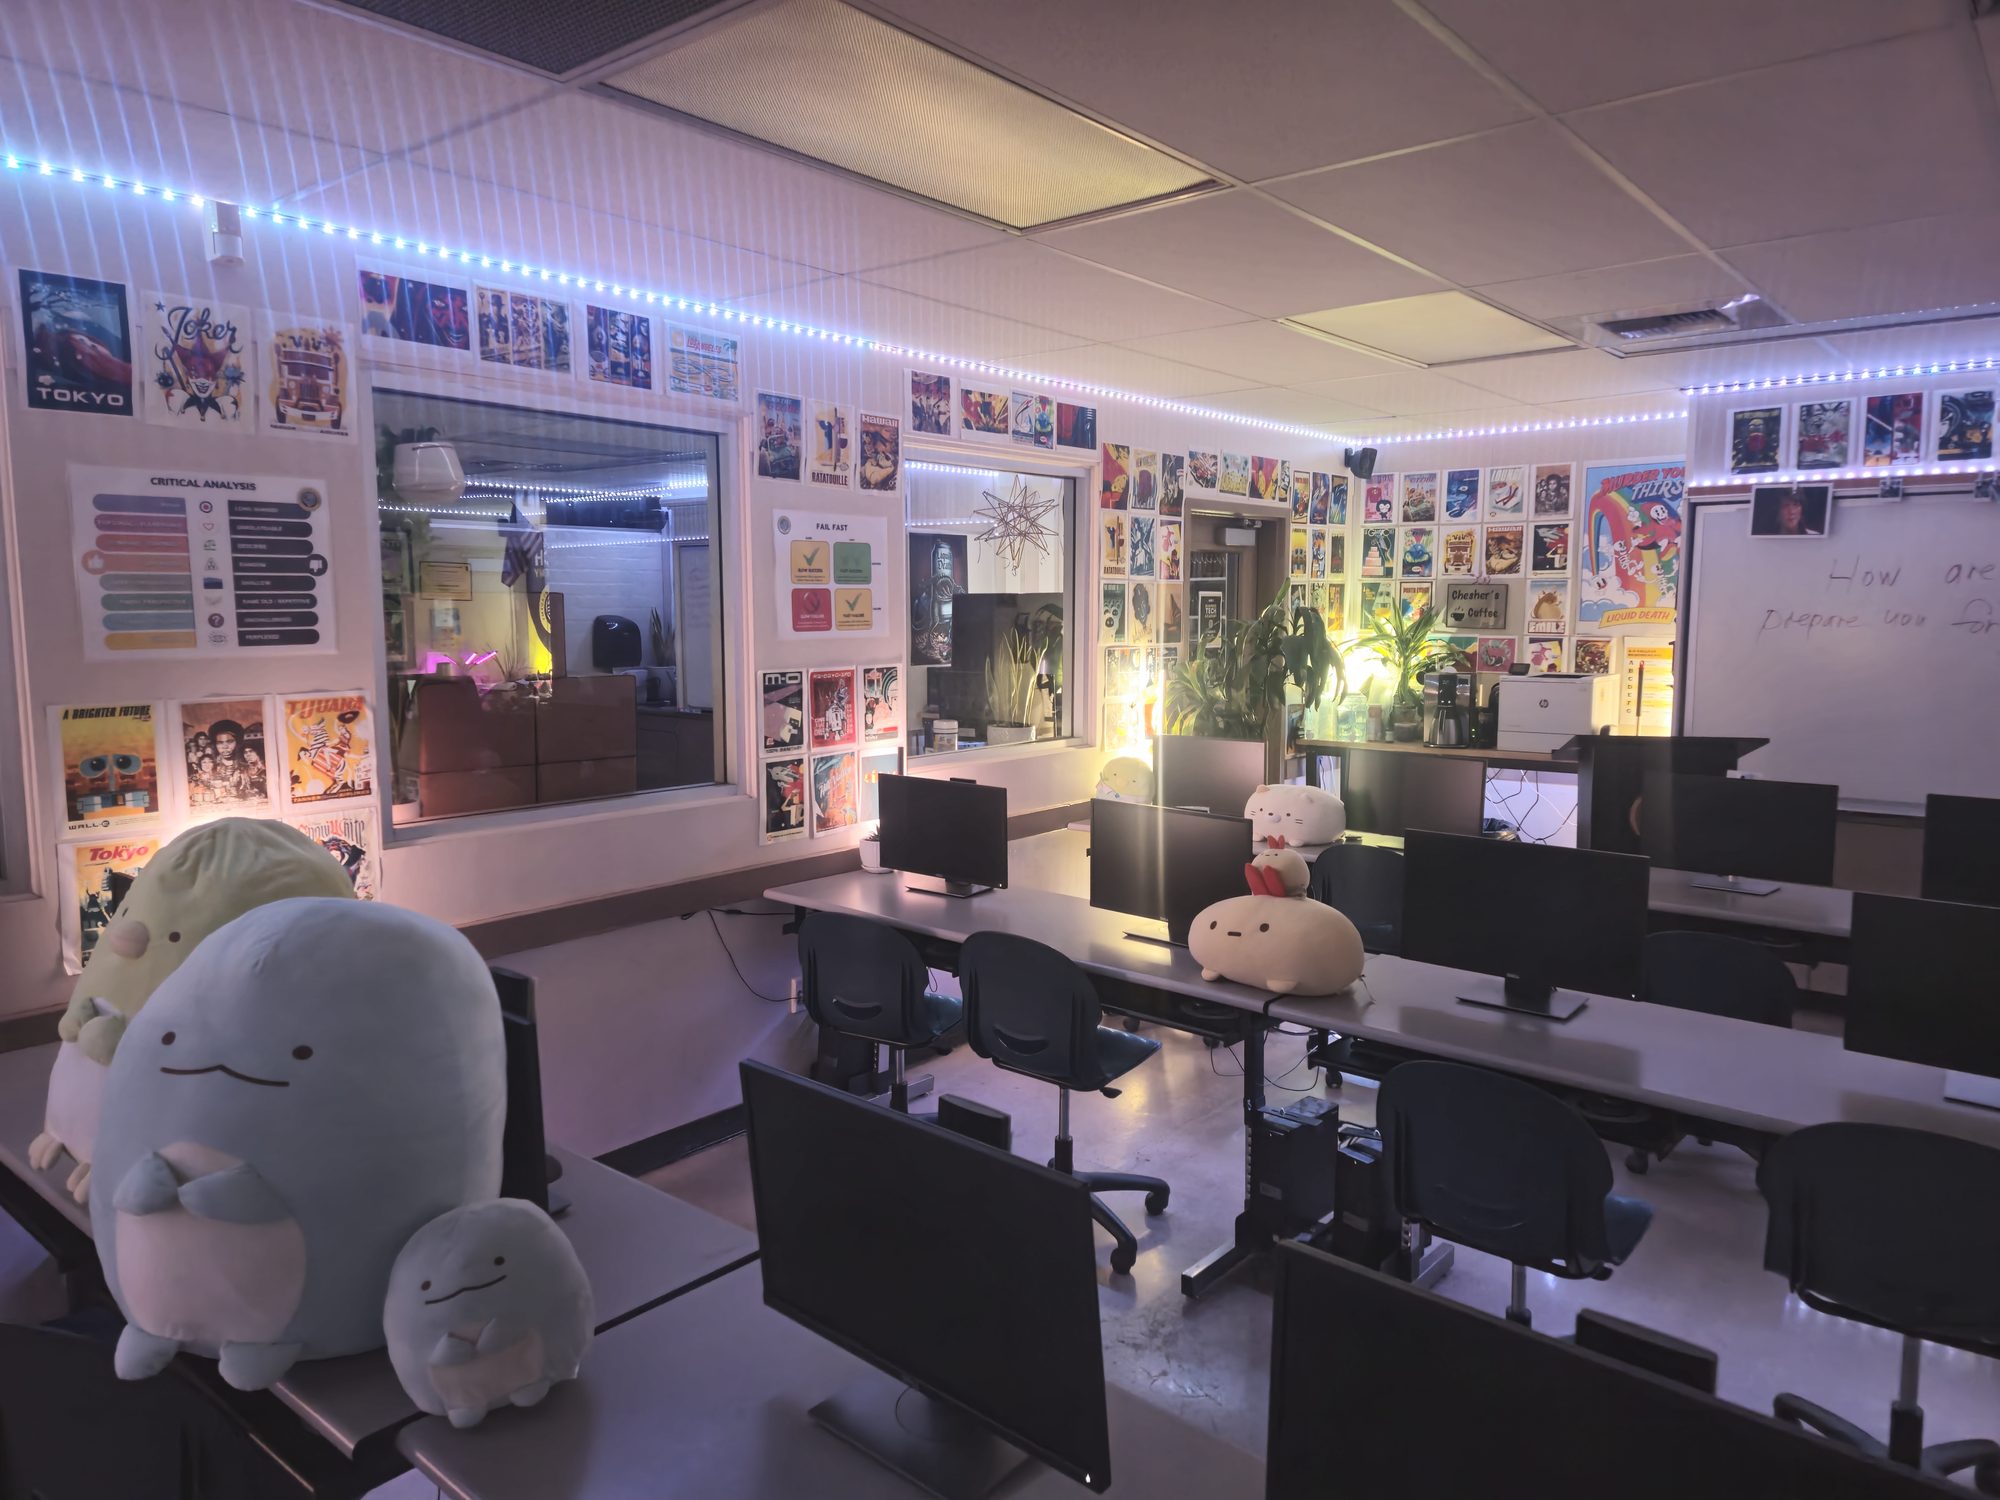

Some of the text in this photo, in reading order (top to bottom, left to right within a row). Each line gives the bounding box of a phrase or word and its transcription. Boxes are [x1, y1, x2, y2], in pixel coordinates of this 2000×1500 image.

[168, 306, 243, 354] Joker
[36, 386, 124, 406] TOKYO
[150, 477, 257, 491] CRITICAL ANALYSIS
[811, 471, 848, 486] RATATOUILLE
[1601, 469, 1660, 496] MURDER
[1631, 479, 1685, 500] THIRS
[816, 522, 848, 532] FAIL FAST
[1826, 555, 1996, 593] How are
[1451, 590, 1501, 601] Chesher's
[1467, 608, 1499, 618] Coffee
[1606, 610, 1671, 623] LIQUID DEATH
[1529, 620, 1566, 634] EMILE
[1539, 698, 1550, 709] hp
[62, 705, 151, 720] A BRIGHTER FUTURE
[89, 845, 150, 862] Tokyo
